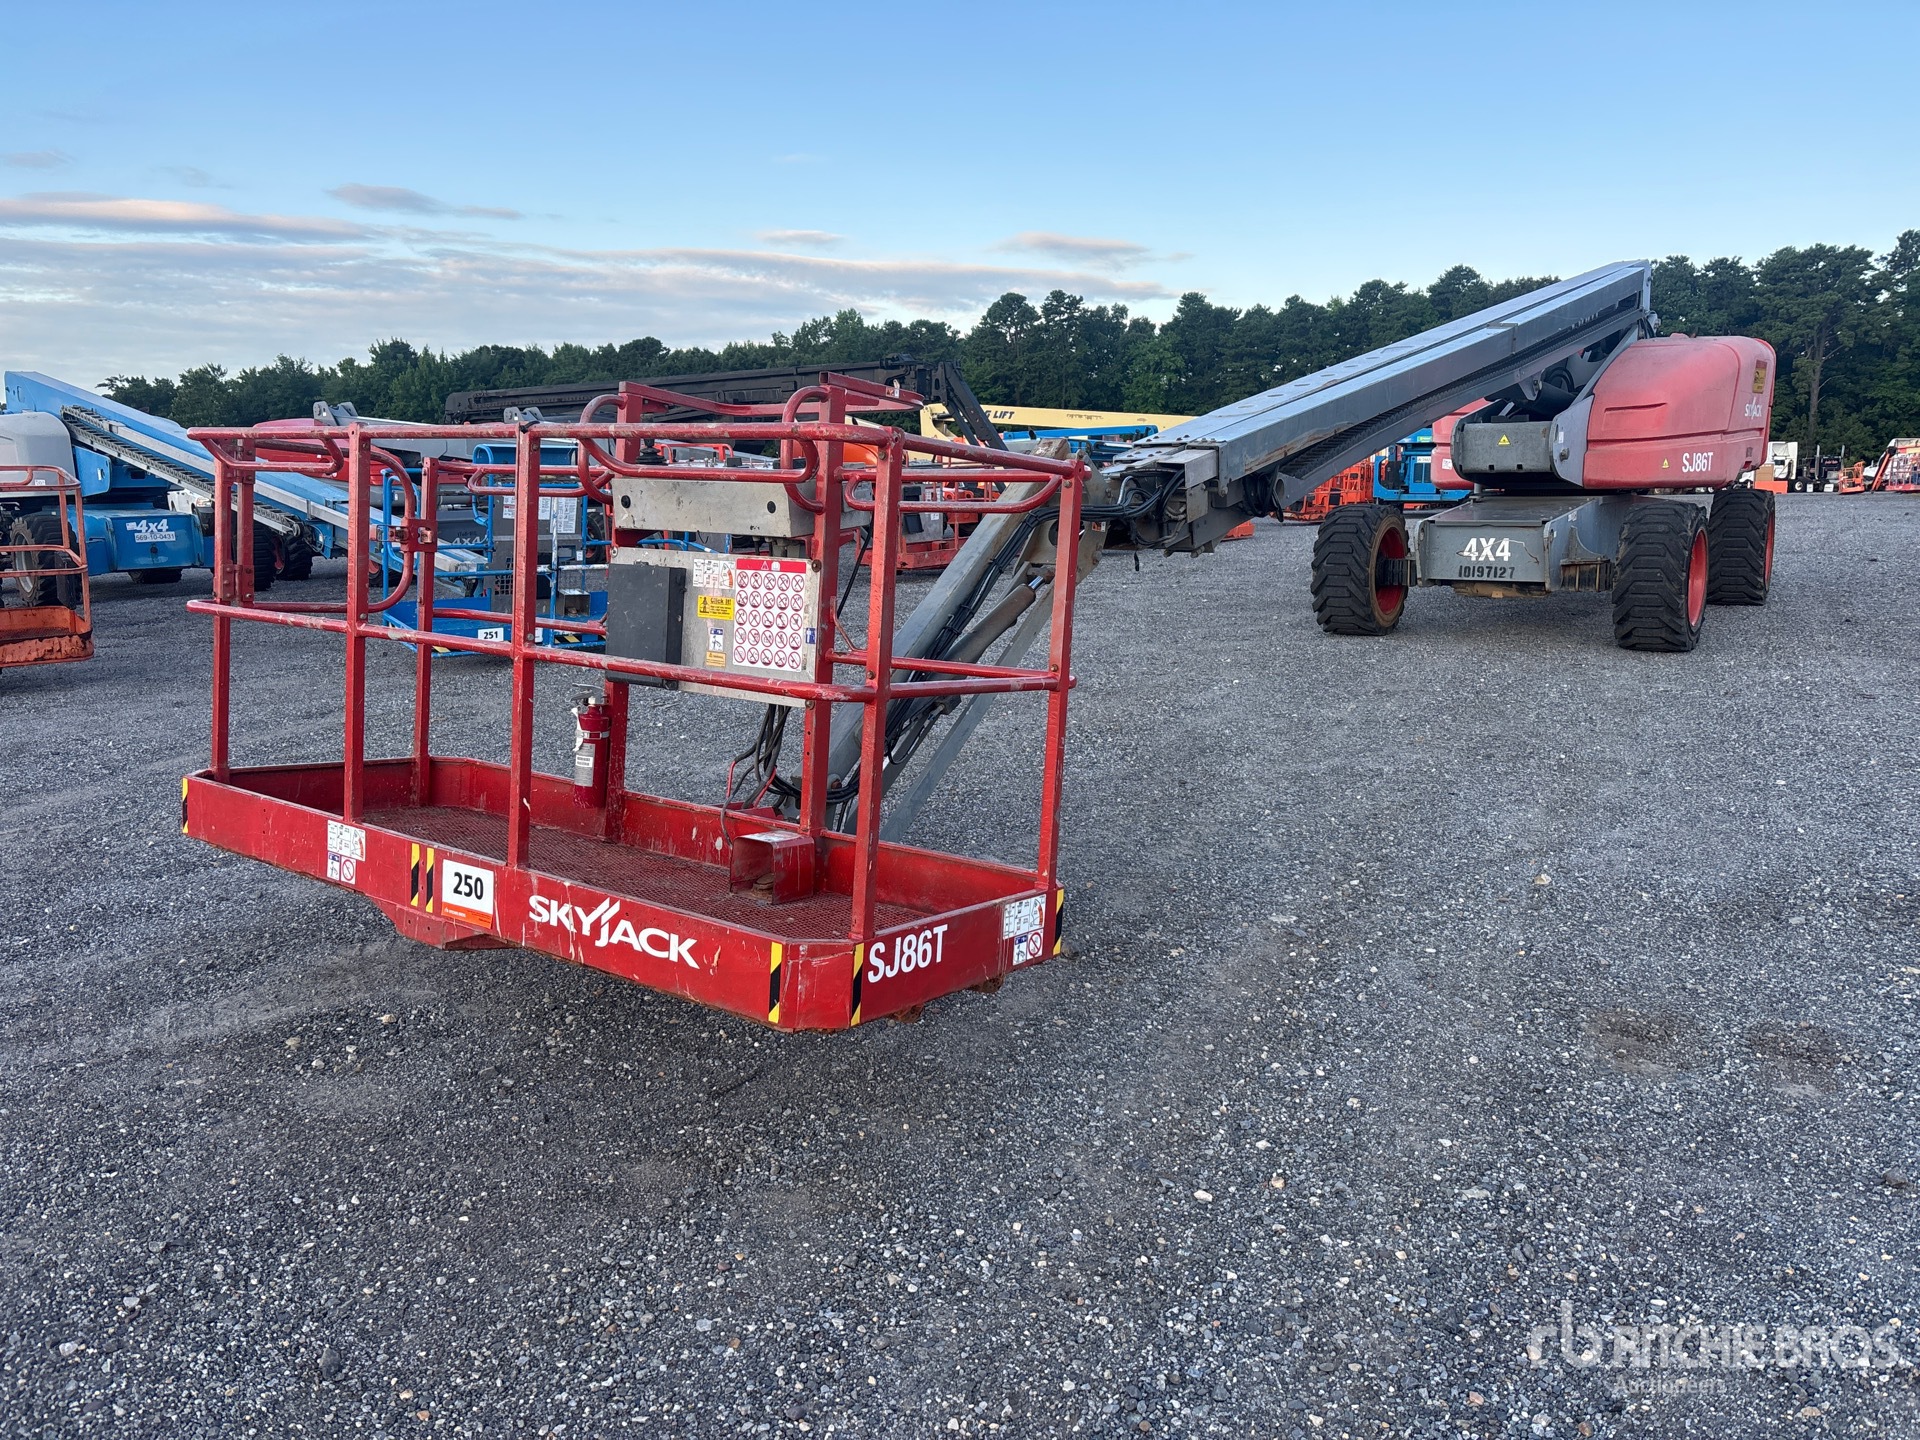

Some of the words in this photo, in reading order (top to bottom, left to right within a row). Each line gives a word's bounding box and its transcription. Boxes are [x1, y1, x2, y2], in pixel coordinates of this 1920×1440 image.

[993, 410, 1015, 420] LIFT
[1682, 452, 1713, 472] SJ86T
[1463, 538, 1511, 561] 4X4
[1459, 565, 1515, 578] 10197127
[483, 631, 499, 640] 251
[453, 872, 484, 900] 250
[528, 895, 700, 970] SKYJACK
[867, 924, 948, 983] SJ86T
